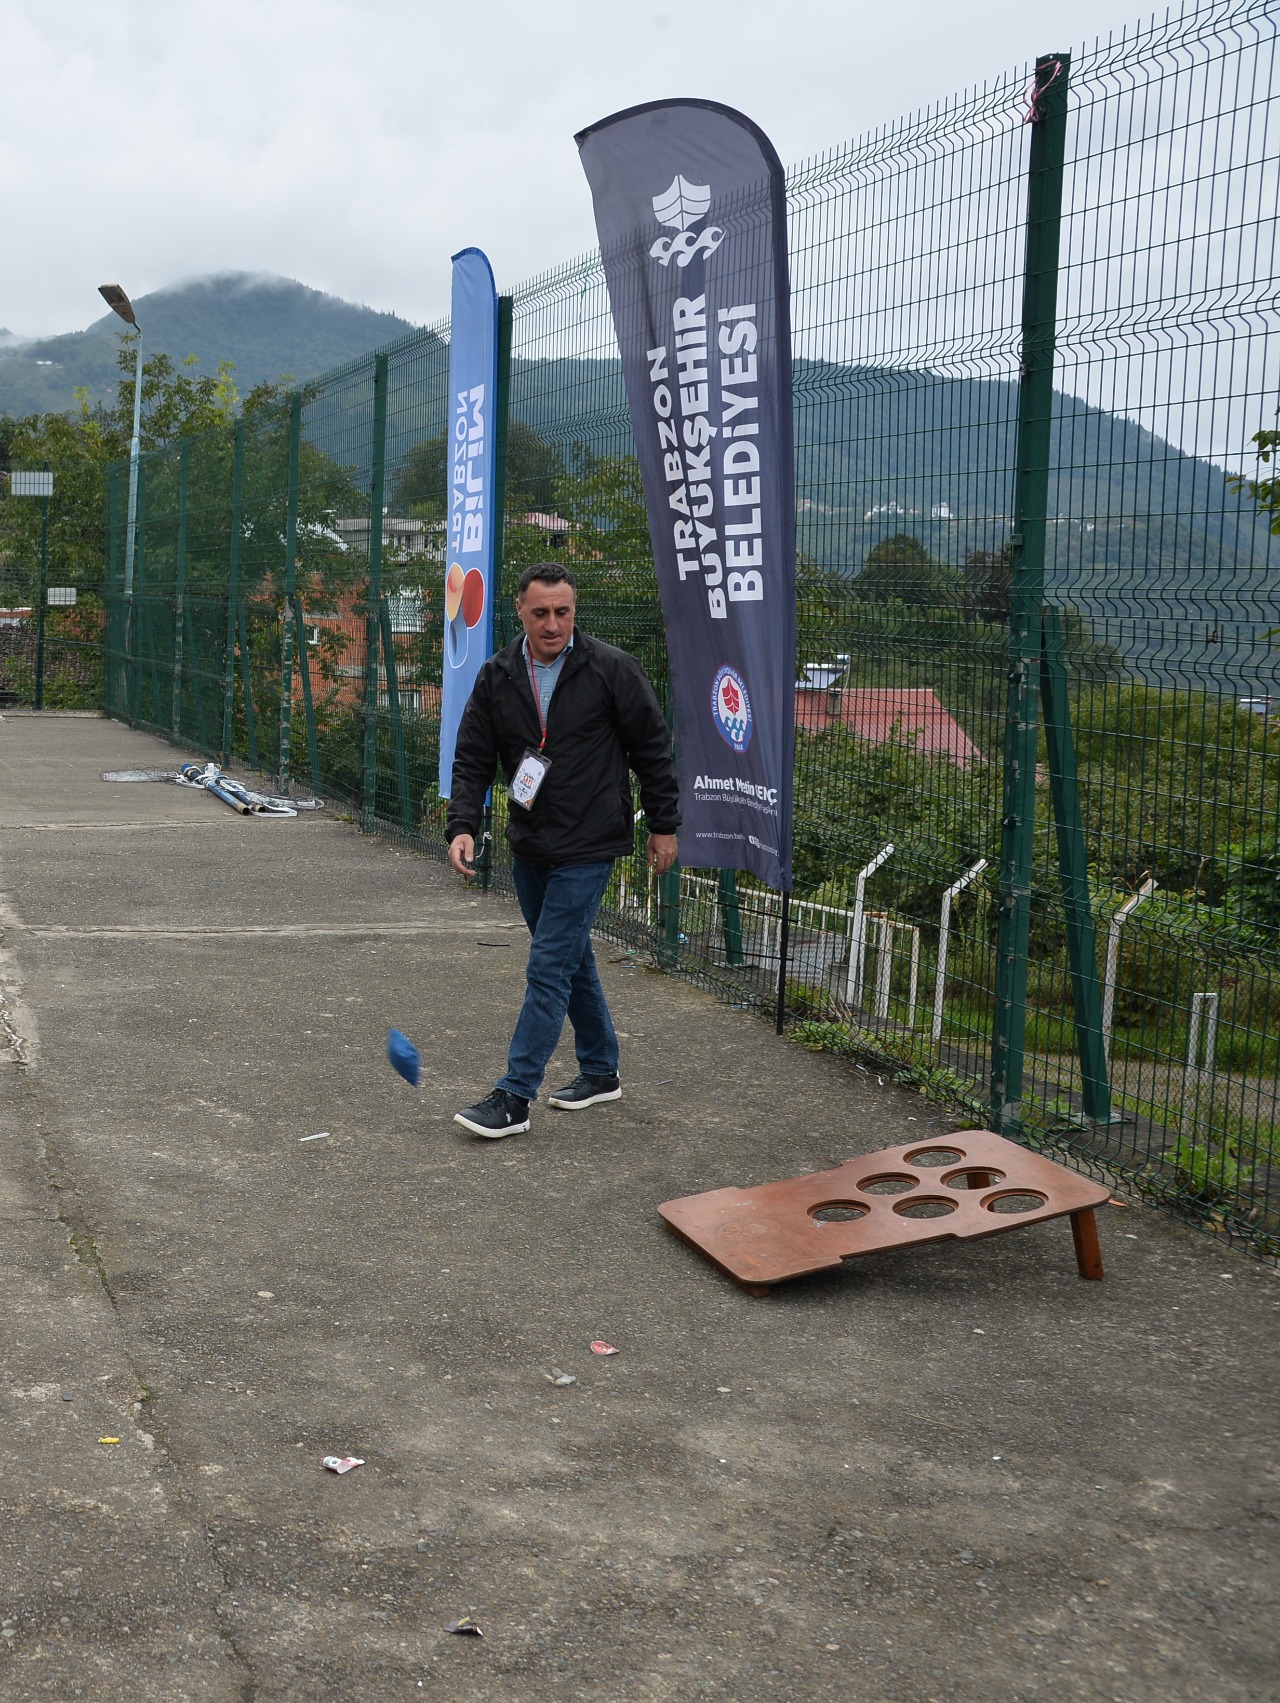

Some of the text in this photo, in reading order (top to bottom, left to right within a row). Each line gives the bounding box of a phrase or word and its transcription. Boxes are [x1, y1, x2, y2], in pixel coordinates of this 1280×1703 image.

[646, 346, 700, 581] TRABZON
[718, 303, 764, 602] BELEDİYESİ
[693, 775, 735, 791] Ahmet
[694, 792, 722, 801] Trabzon
